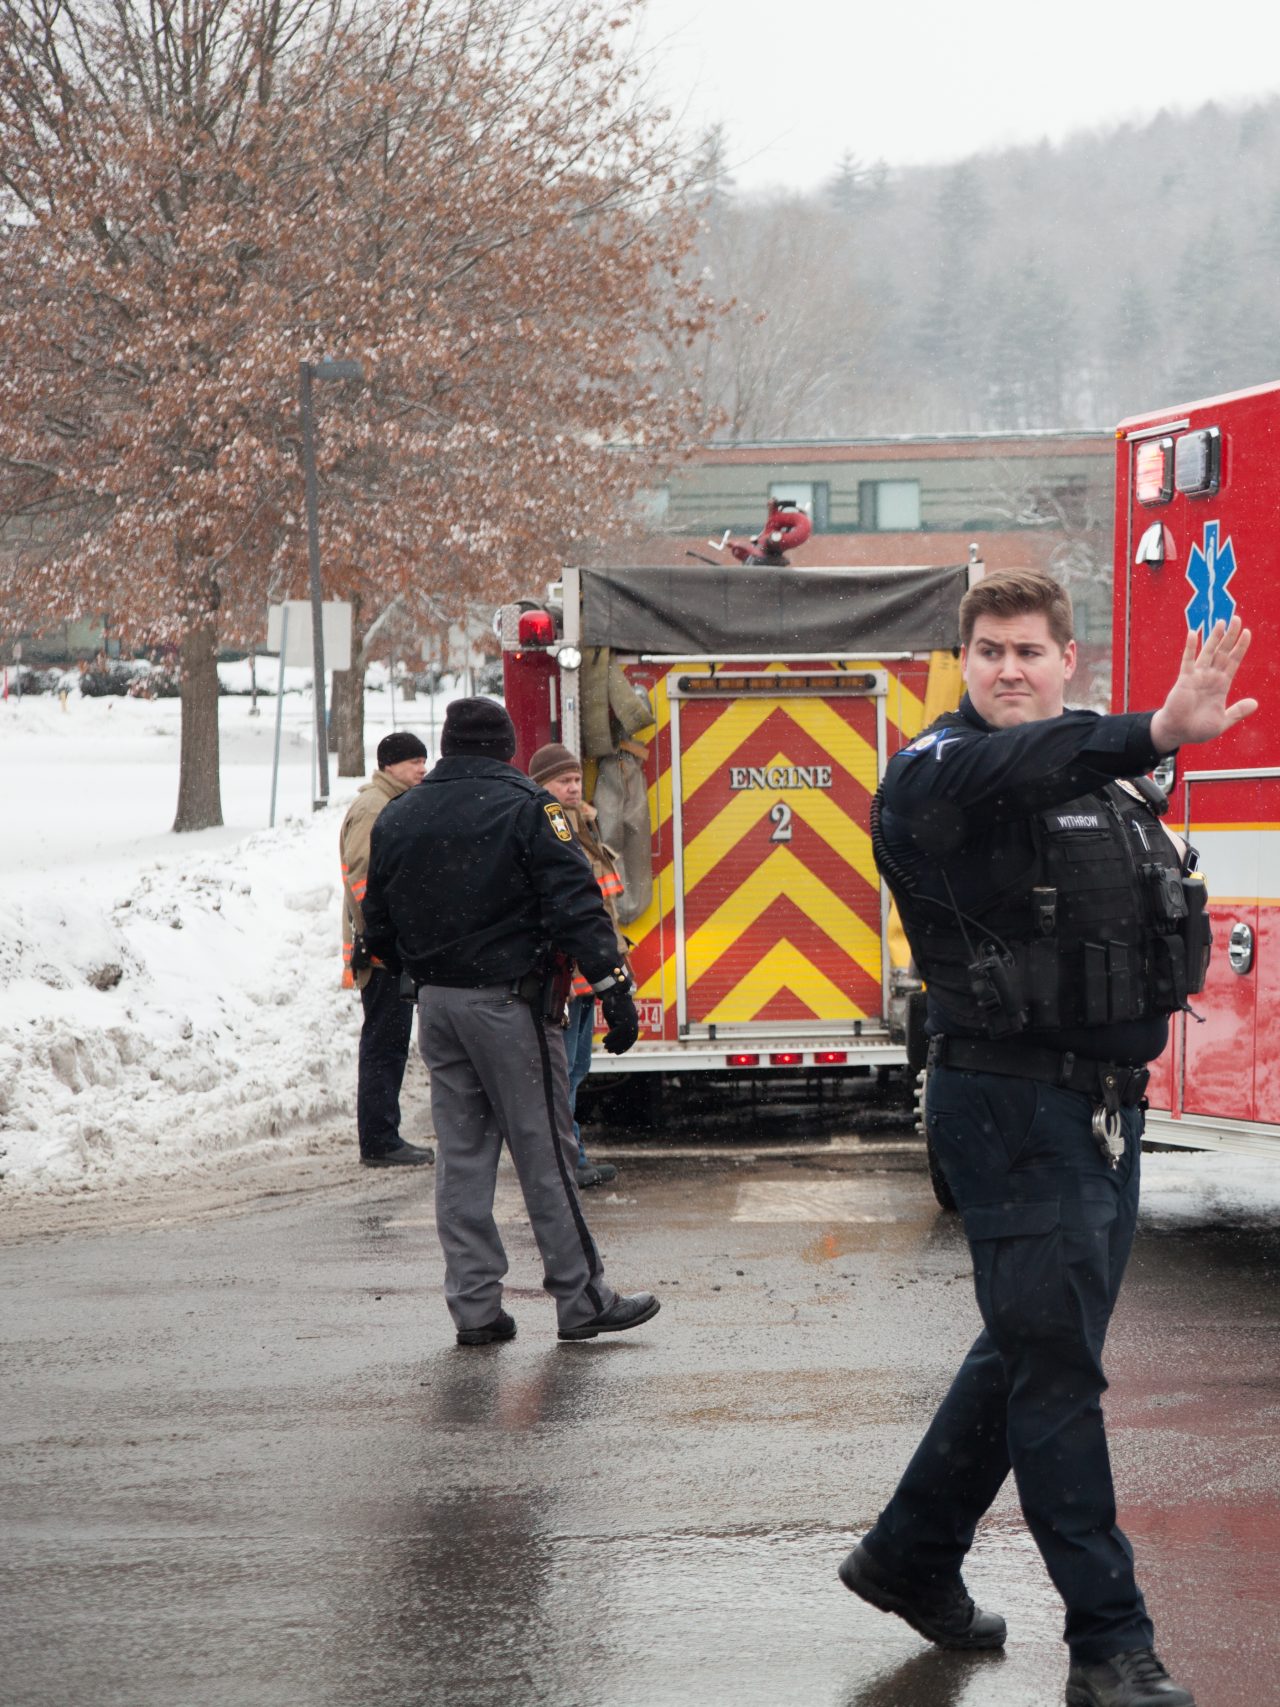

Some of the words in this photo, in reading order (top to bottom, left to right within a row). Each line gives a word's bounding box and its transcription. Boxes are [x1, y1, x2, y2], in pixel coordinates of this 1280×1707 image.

[729, 766, 832, 791] ENGINE
[770, 803, 793, 844] 2
[1056, 815, 1099, 828] WITHROW
